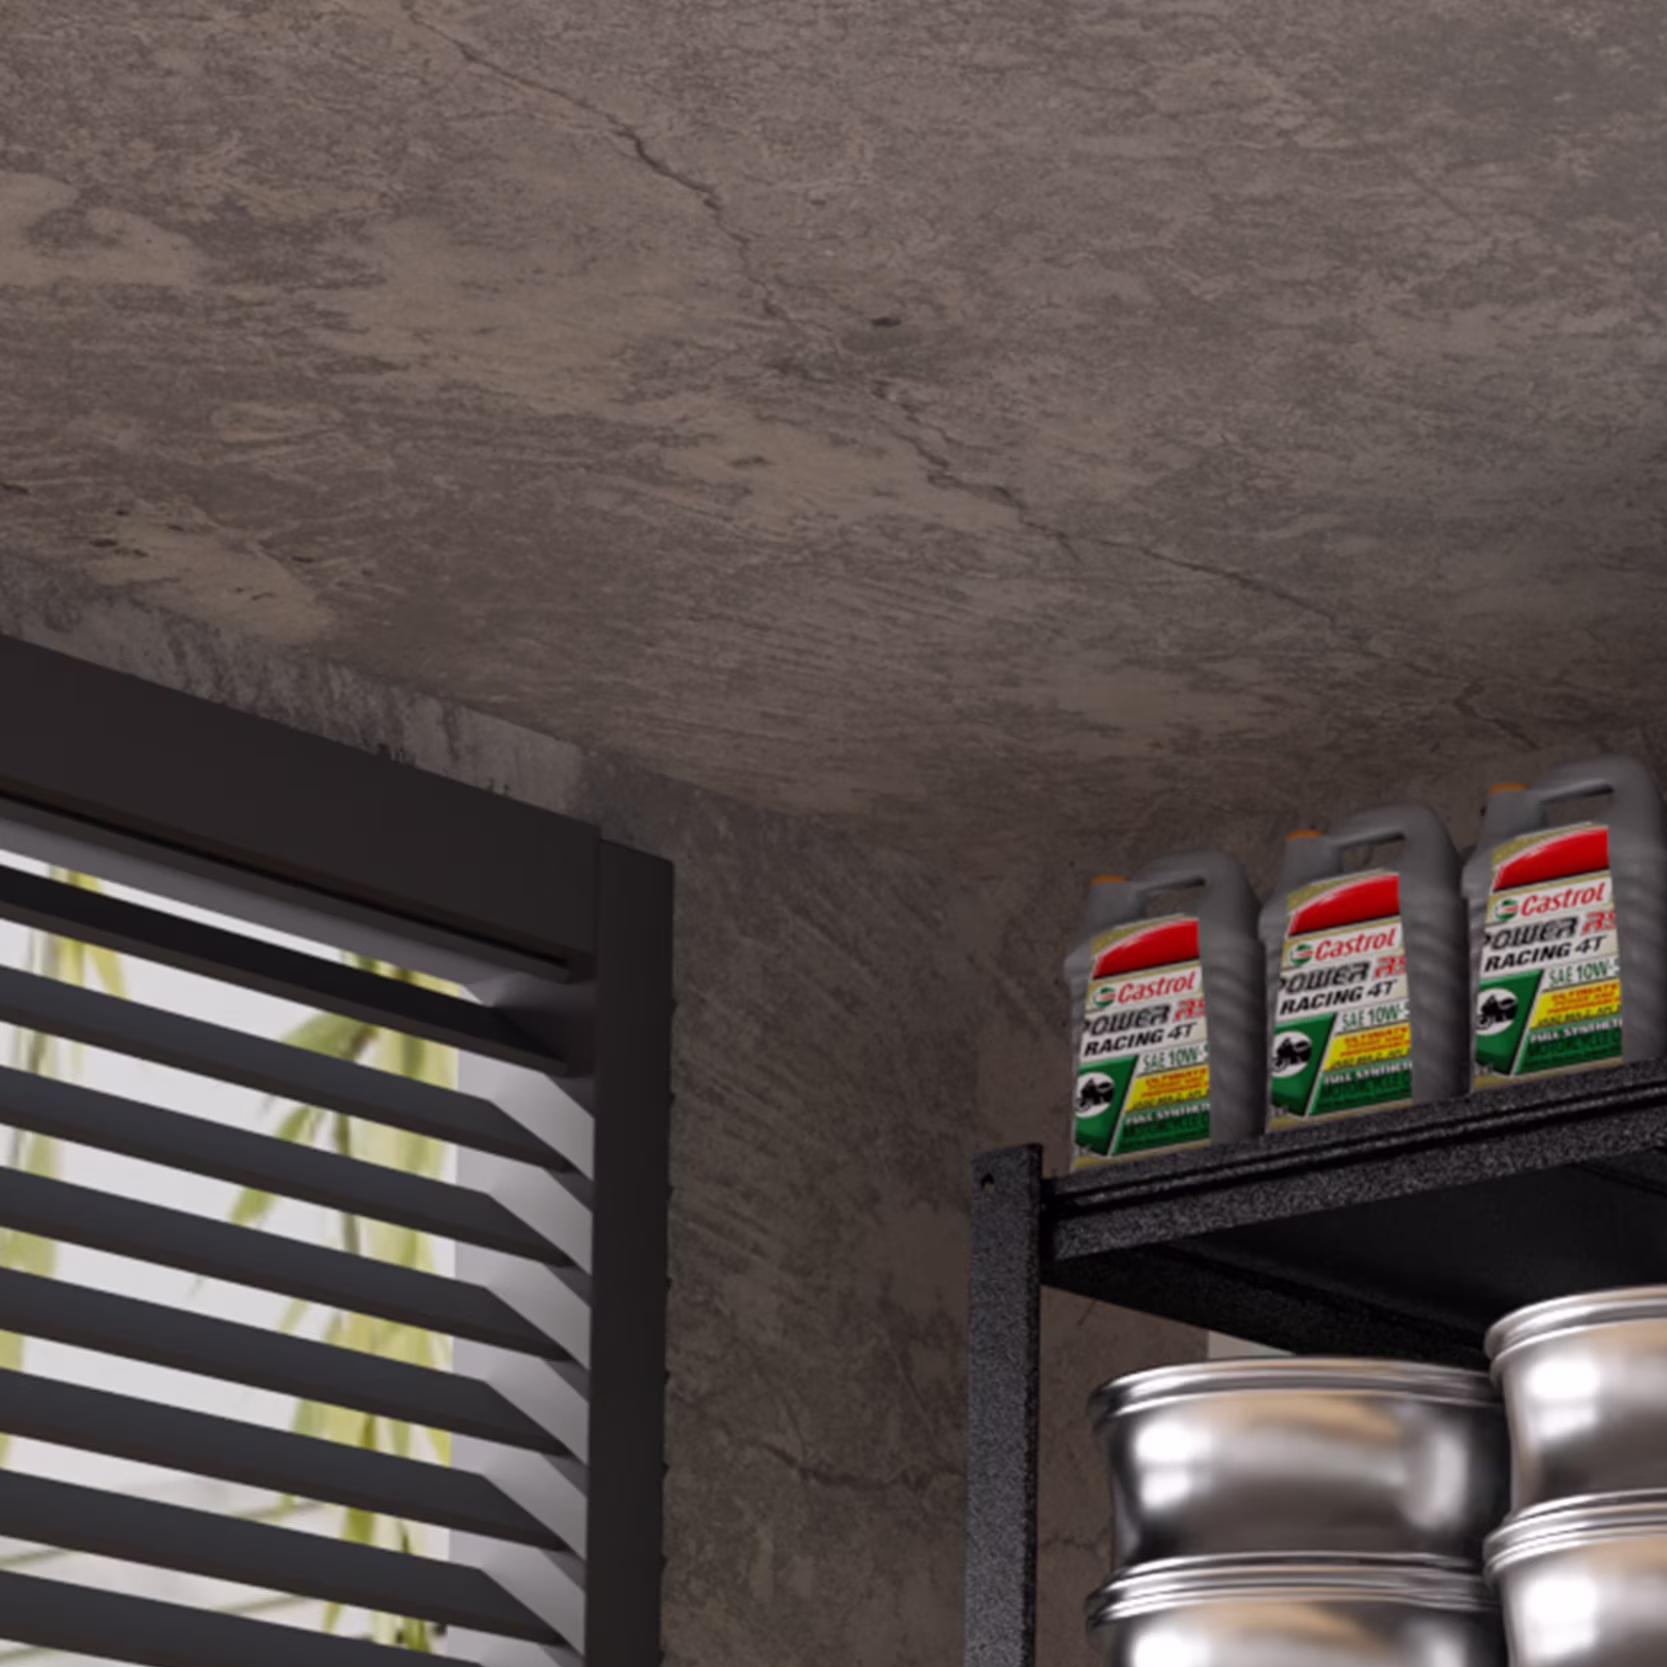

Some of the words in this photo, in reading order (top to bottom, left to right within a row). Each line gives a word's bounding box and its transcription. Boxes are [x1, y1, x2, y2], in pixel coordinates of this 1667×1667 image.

[1521, 881, 1605, 917] Castrol
[1315, 927, 1397, 961] Castrol
[1485, 942, 1571, 972] RACING
[1575, 935, 1607, 953] 4T
[1118, 971, 1196, 1003] Castrol
[1549, 968, 1574, 987] SAE
[1280, 985, 1362, 1015] RACING
[1367, 980, 1398, 997] 4T
[1342, 1011, 1365, 1031] SAE
[1084, 1027, 1162, 1056] RACING
[1168, 1022, 1197, 1039] 4T
[1143, 1053, 1166, 1072] SAE
